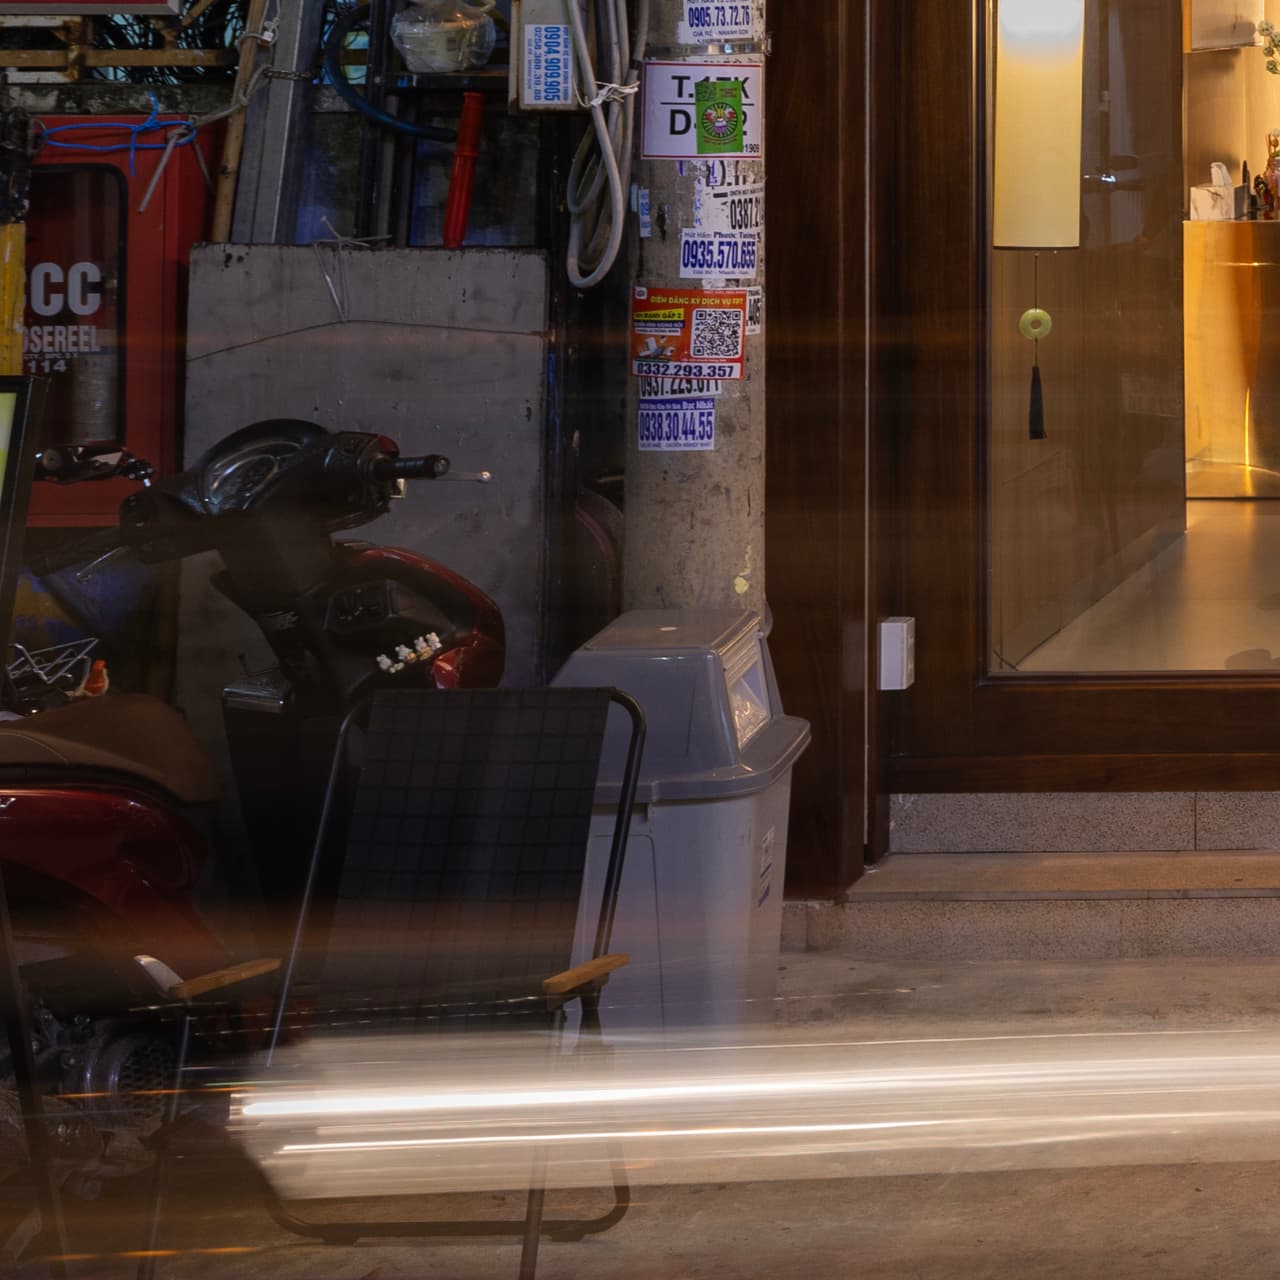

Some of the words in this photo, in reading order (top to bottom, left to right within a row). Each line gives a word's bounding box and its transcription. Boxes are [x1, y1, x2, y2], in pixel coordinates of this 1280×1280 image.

[688, 5, 750, 28] 0905.73.72.76
[544, 26, 561, 101] 0904.909.905
[682, 239, 756, 269] 0935.570.655
[24, 261, 102, 316] CC
[27, 360, 66, 374] 114
[636, 362, 734, 378] 0332.293.357
[639, 412, 713, 441] 0938.30.44.55
